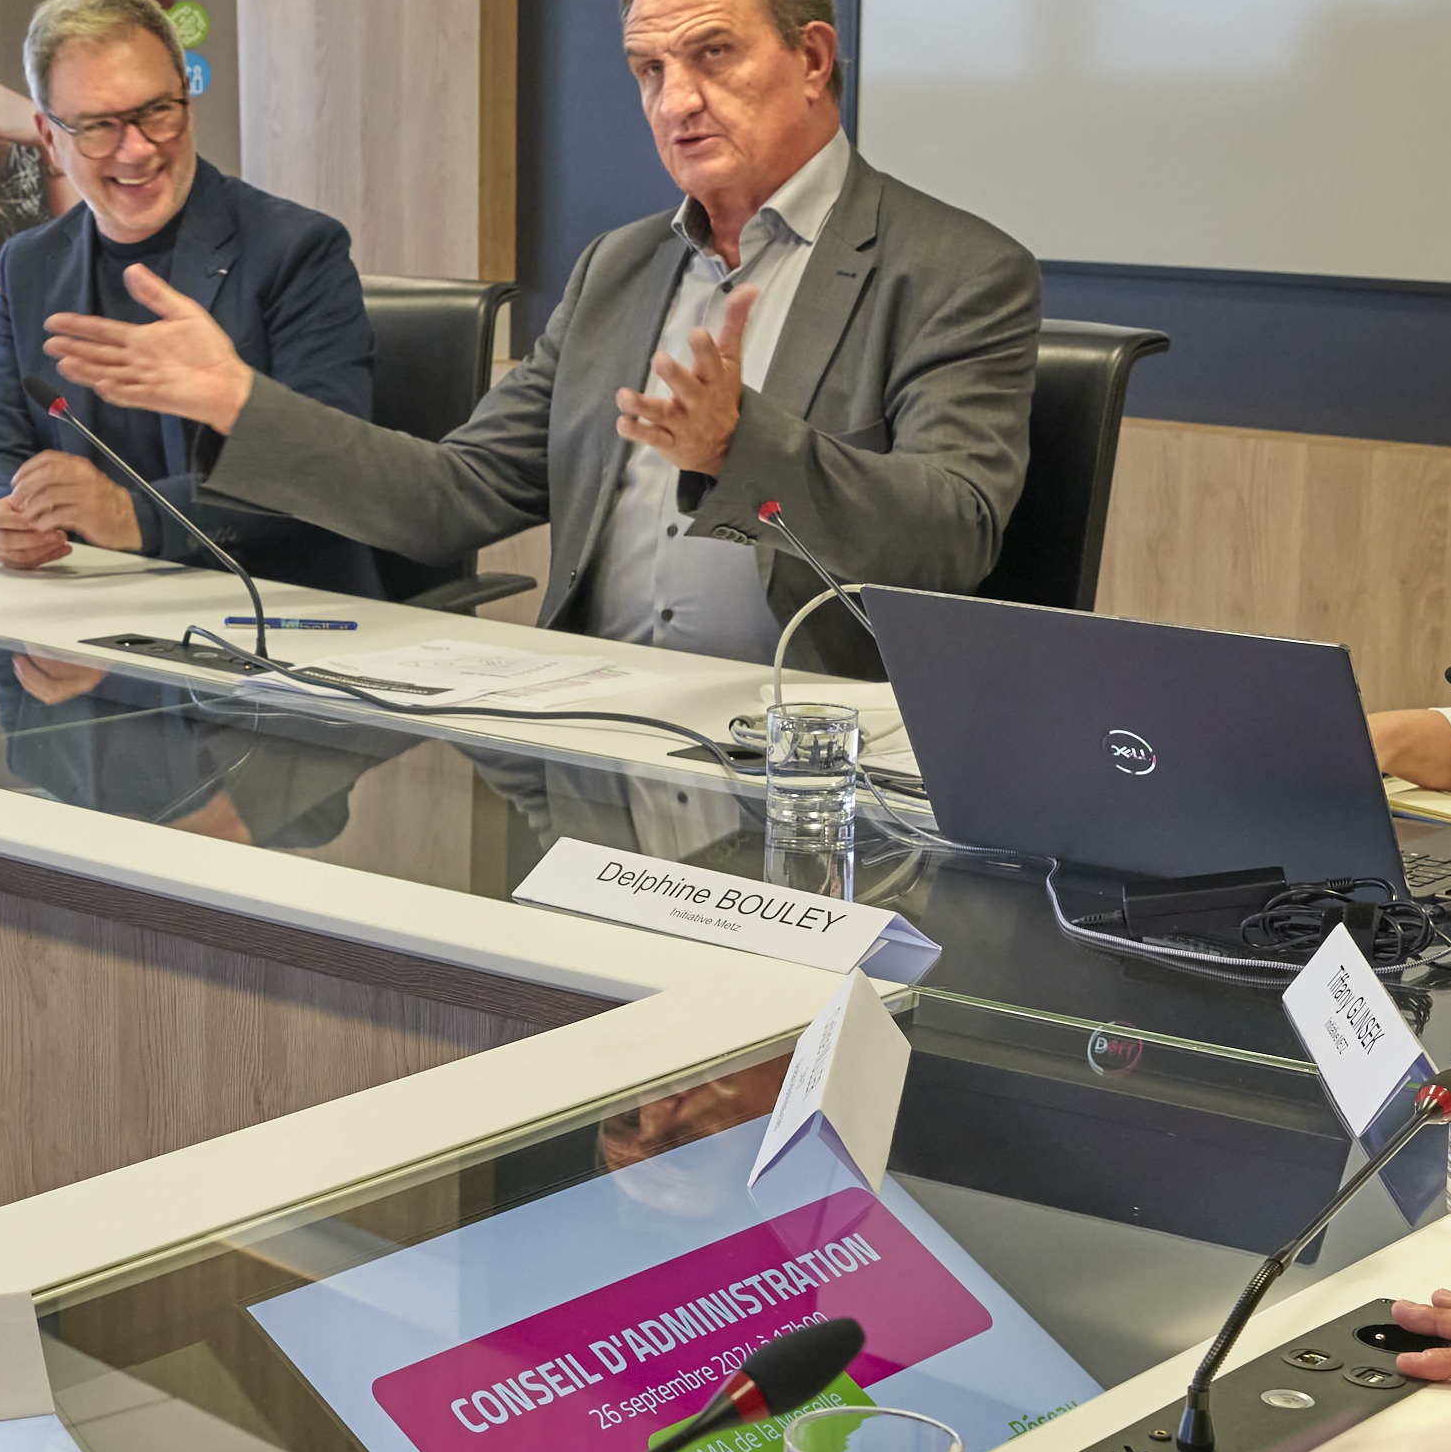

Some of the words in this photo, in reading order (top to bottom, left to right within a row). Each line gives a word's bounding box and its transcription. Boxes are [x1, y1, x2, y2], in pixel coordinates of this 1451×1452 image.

[597, 861, 711, 904] Delphine
[715, 889, 847, 933] BOULEY
[669, 907, 713, 925] Initiative
[714, 918, 742, 932] Metz
[1327, 965, 1355, 1014] Tiffany
[1346, 996, 1385, 1055] GLINSEK
[451, 1353, 603, 1433] CONSEIL
[588, 1232, 881, 1376] D'ADMINISTRATION
[589, 1403, 621, 1430] 26
[618, 1364, 718, 1419] septembre
[735, 1430, 762, 1452] de
[754, 1423, 782, 1442] la
